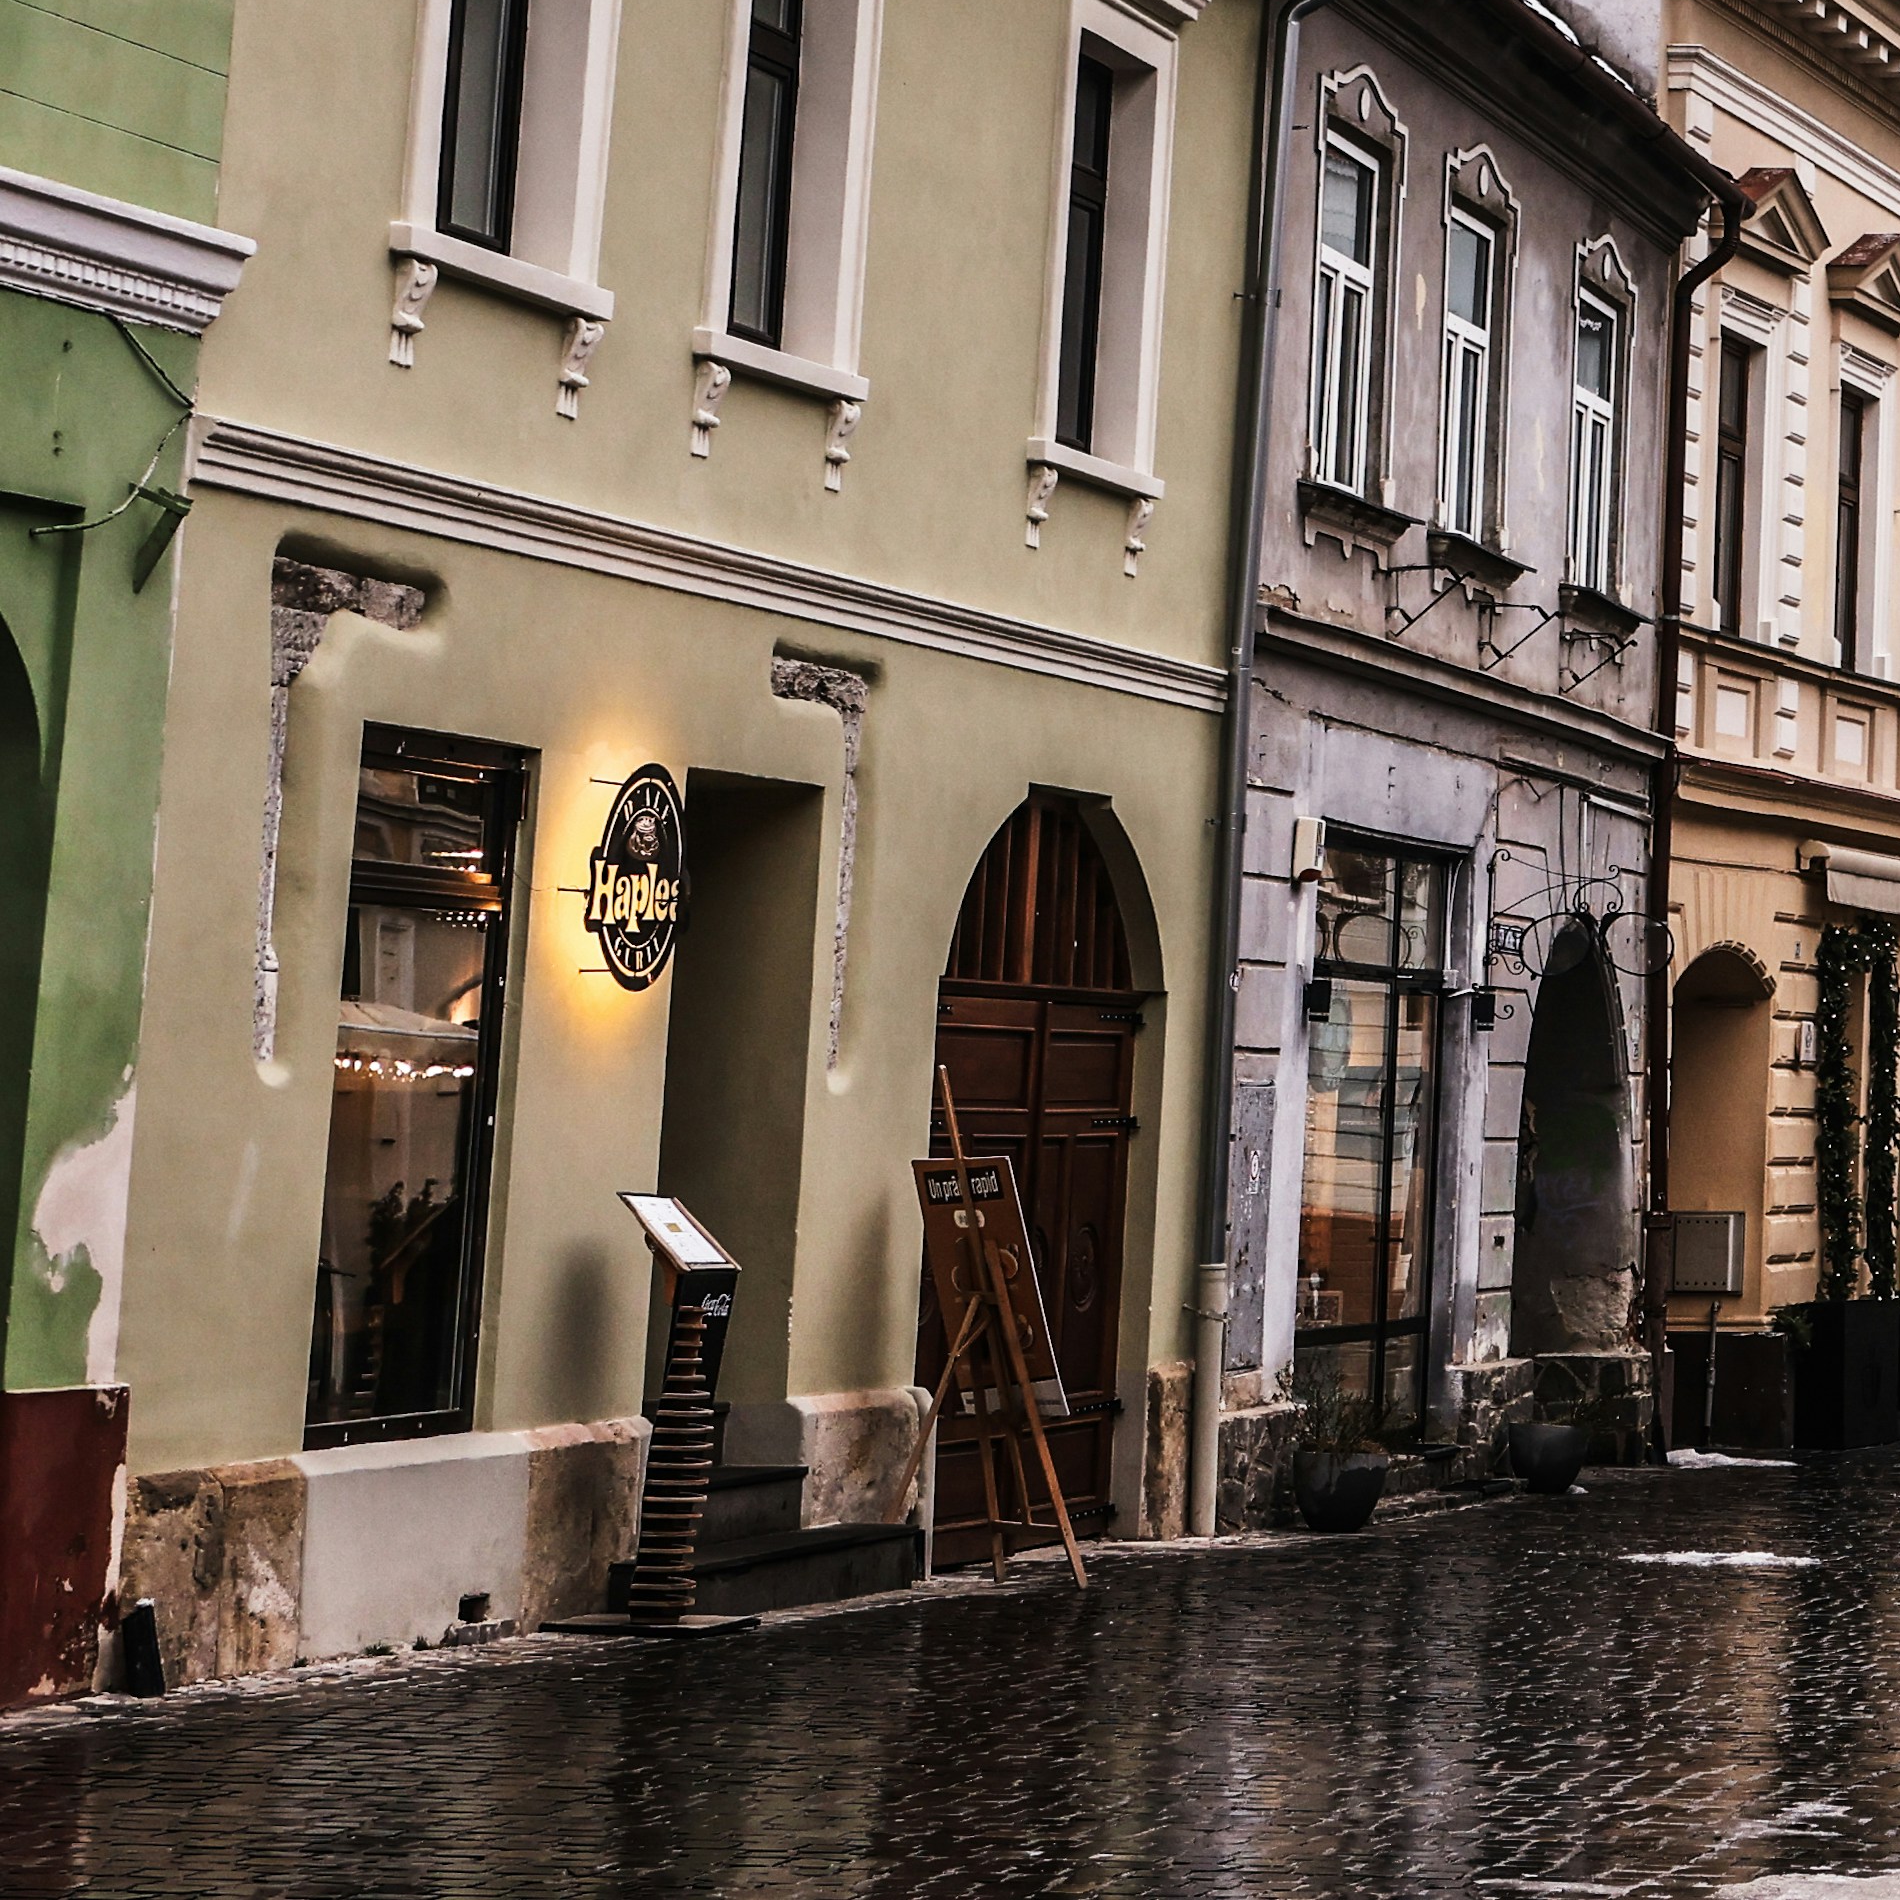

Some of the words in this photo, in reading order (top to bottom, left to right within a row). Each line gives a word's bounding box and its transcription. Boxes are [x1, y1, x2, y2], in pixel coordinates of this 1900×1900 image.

[927, 1178, 943, 1199] Un
[943, 1175, 962, 1202] prâ
[971, 1171, 999, 1200] rapid
